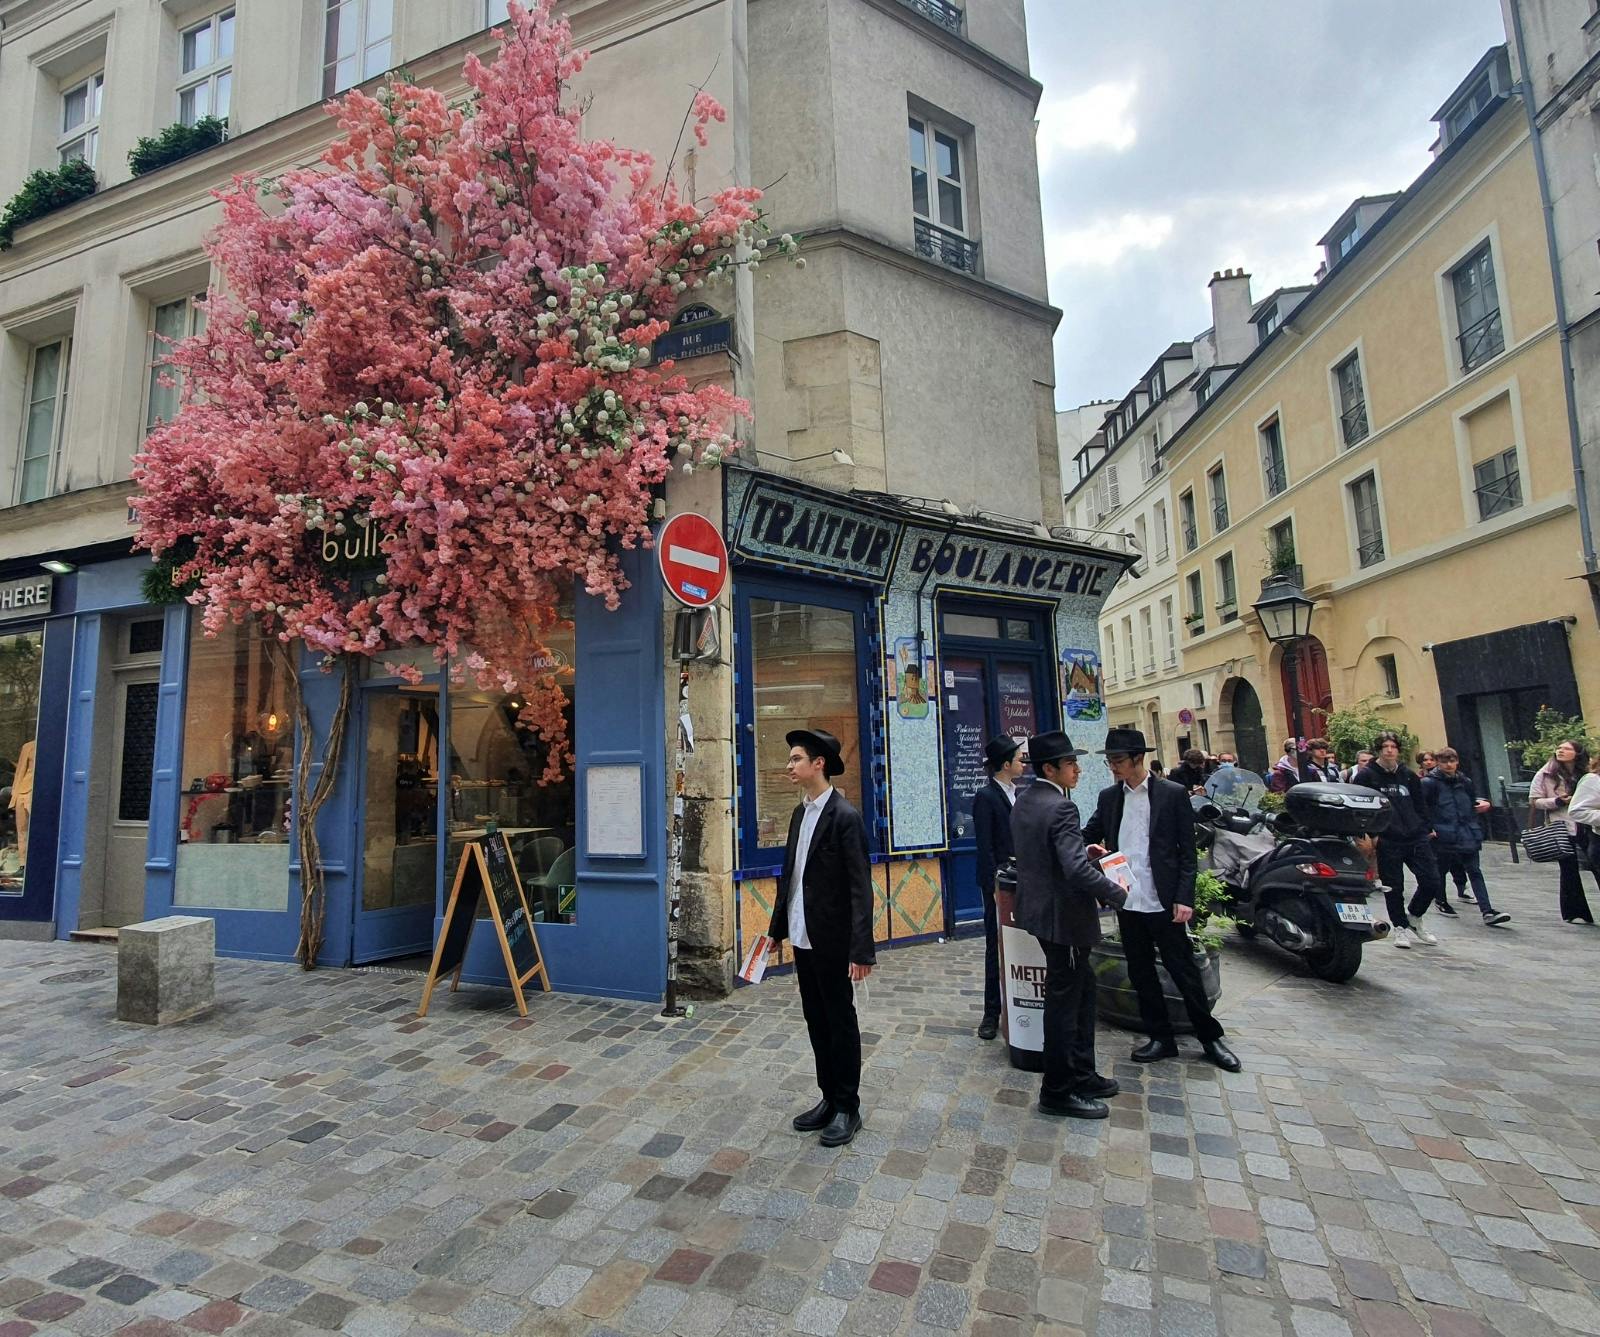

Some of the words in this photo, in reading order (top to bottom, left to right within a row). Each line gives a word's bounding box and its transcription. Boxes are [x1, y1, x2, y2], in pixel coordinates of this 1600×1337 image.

[682, 333, 702, 346] RUE
[750, 495, 892, 567] TRAITEUR
[910, 538, 1109, 597] BOULANGERIE
[0, 583, 49, 609] HERE
[1004, 706, 1031, 719] Yiddish
[1005, 725, 1035, 739] LORENC
[1009, 911, 1016, 922] L
[1010, 963, 1047, 984] METT
[1031, 982, 1047, 999] TE
